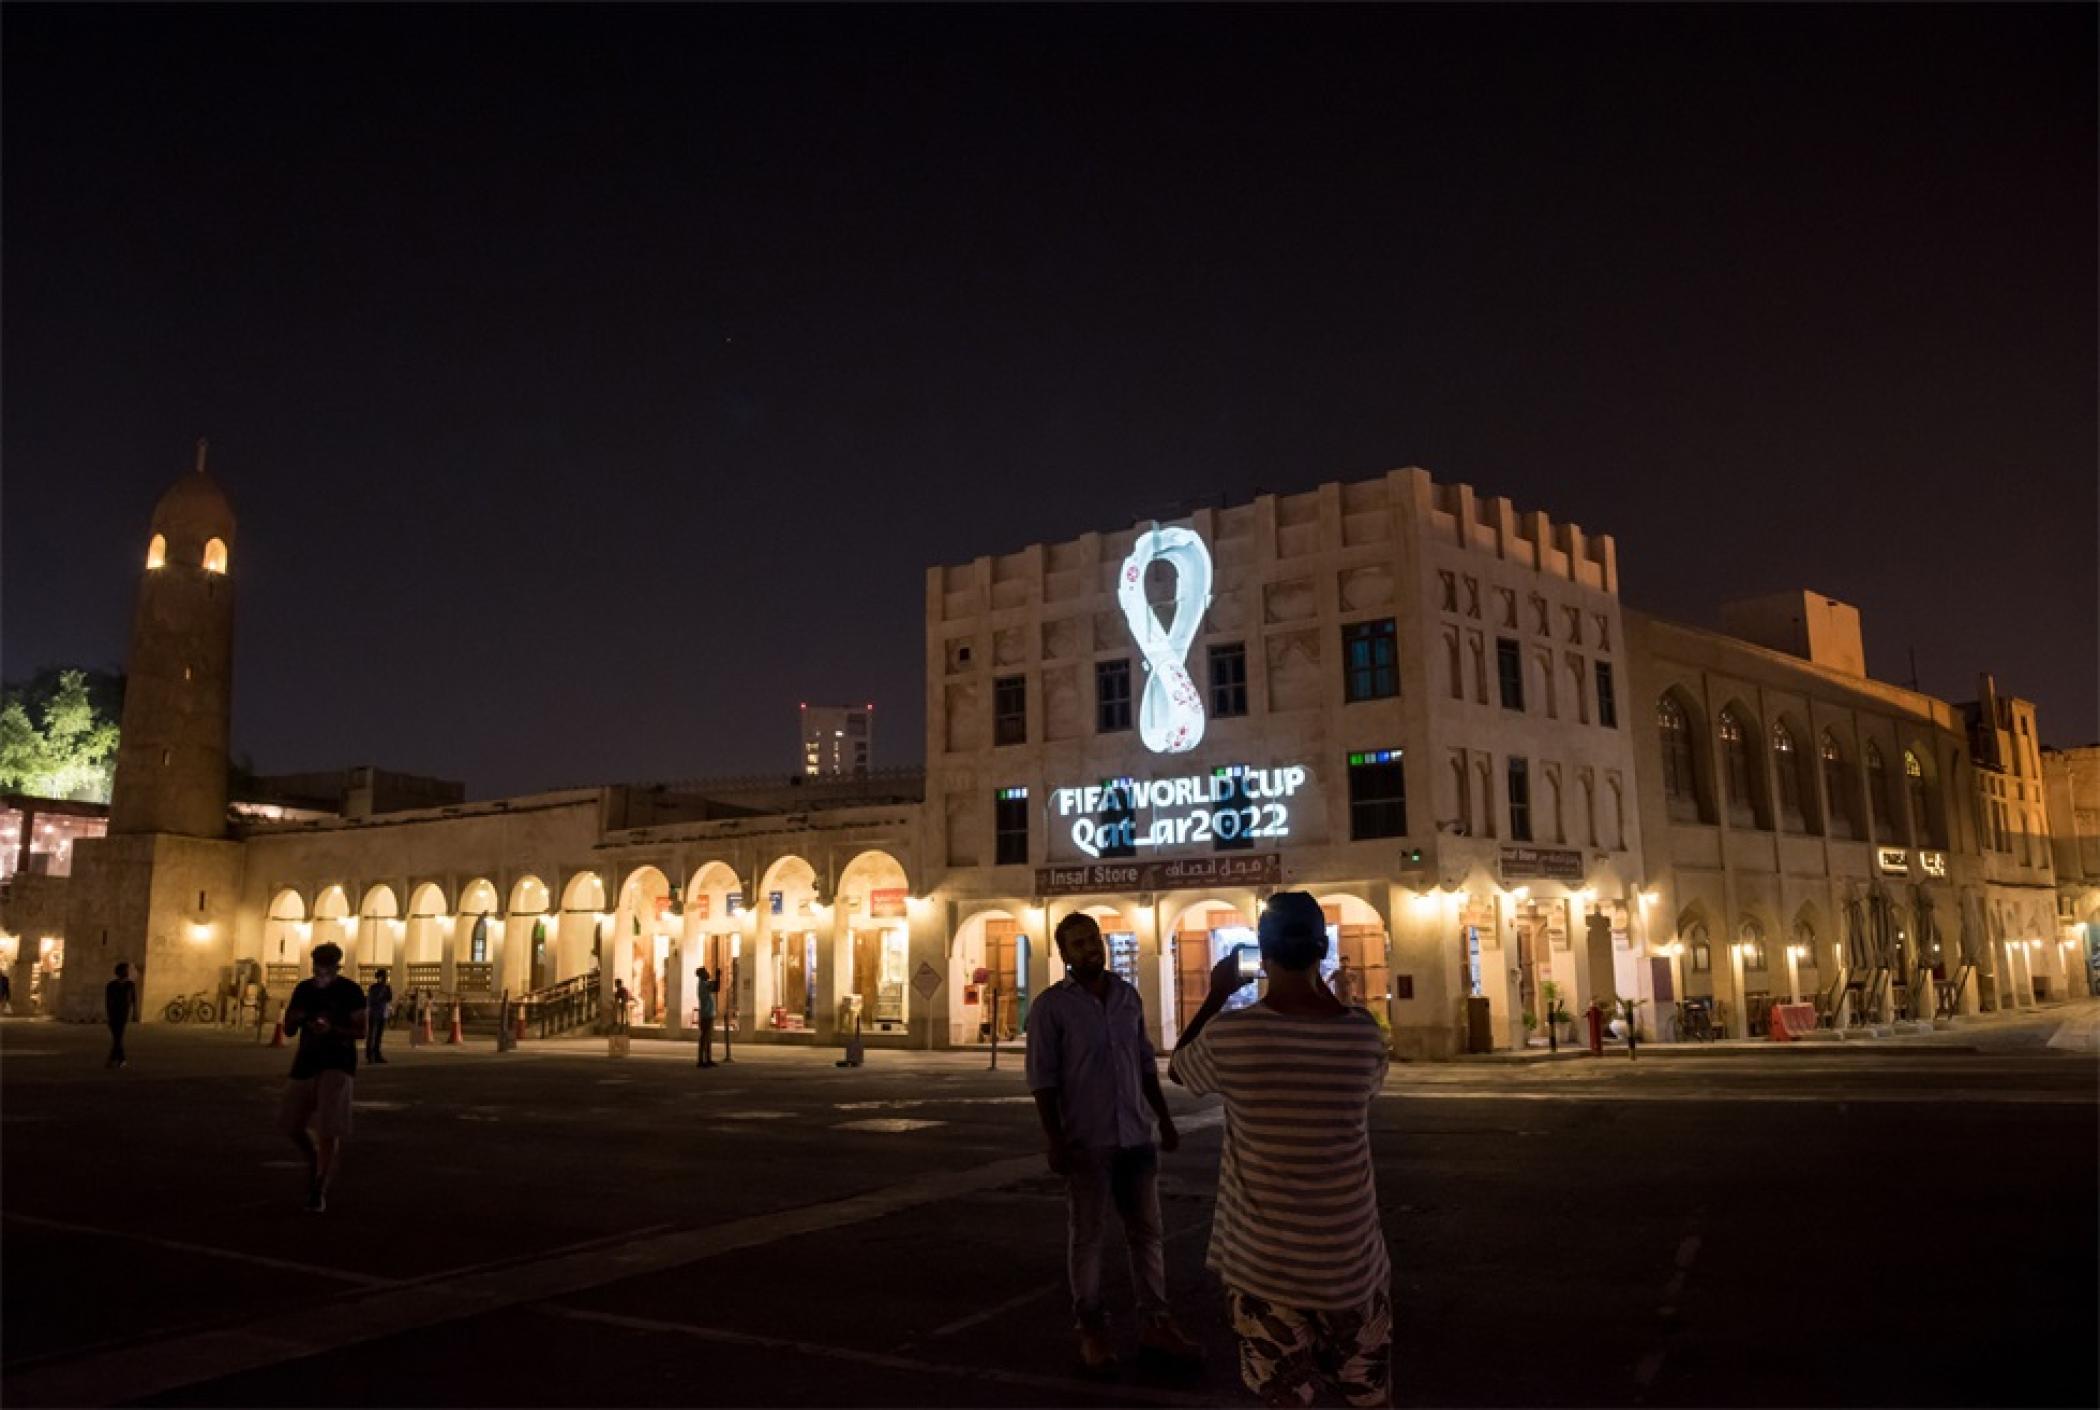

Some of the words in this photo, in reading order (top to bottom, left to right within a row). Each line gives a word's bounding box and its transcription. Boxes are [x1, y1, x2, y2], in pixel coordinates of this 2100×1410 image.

[1058, 786, 1121, 816] FIFA
[1124, 775, 1235, 810] WORLD
[1242, 766, 1306, 799] CUP
[1094, 865, 1139, 883] Store
